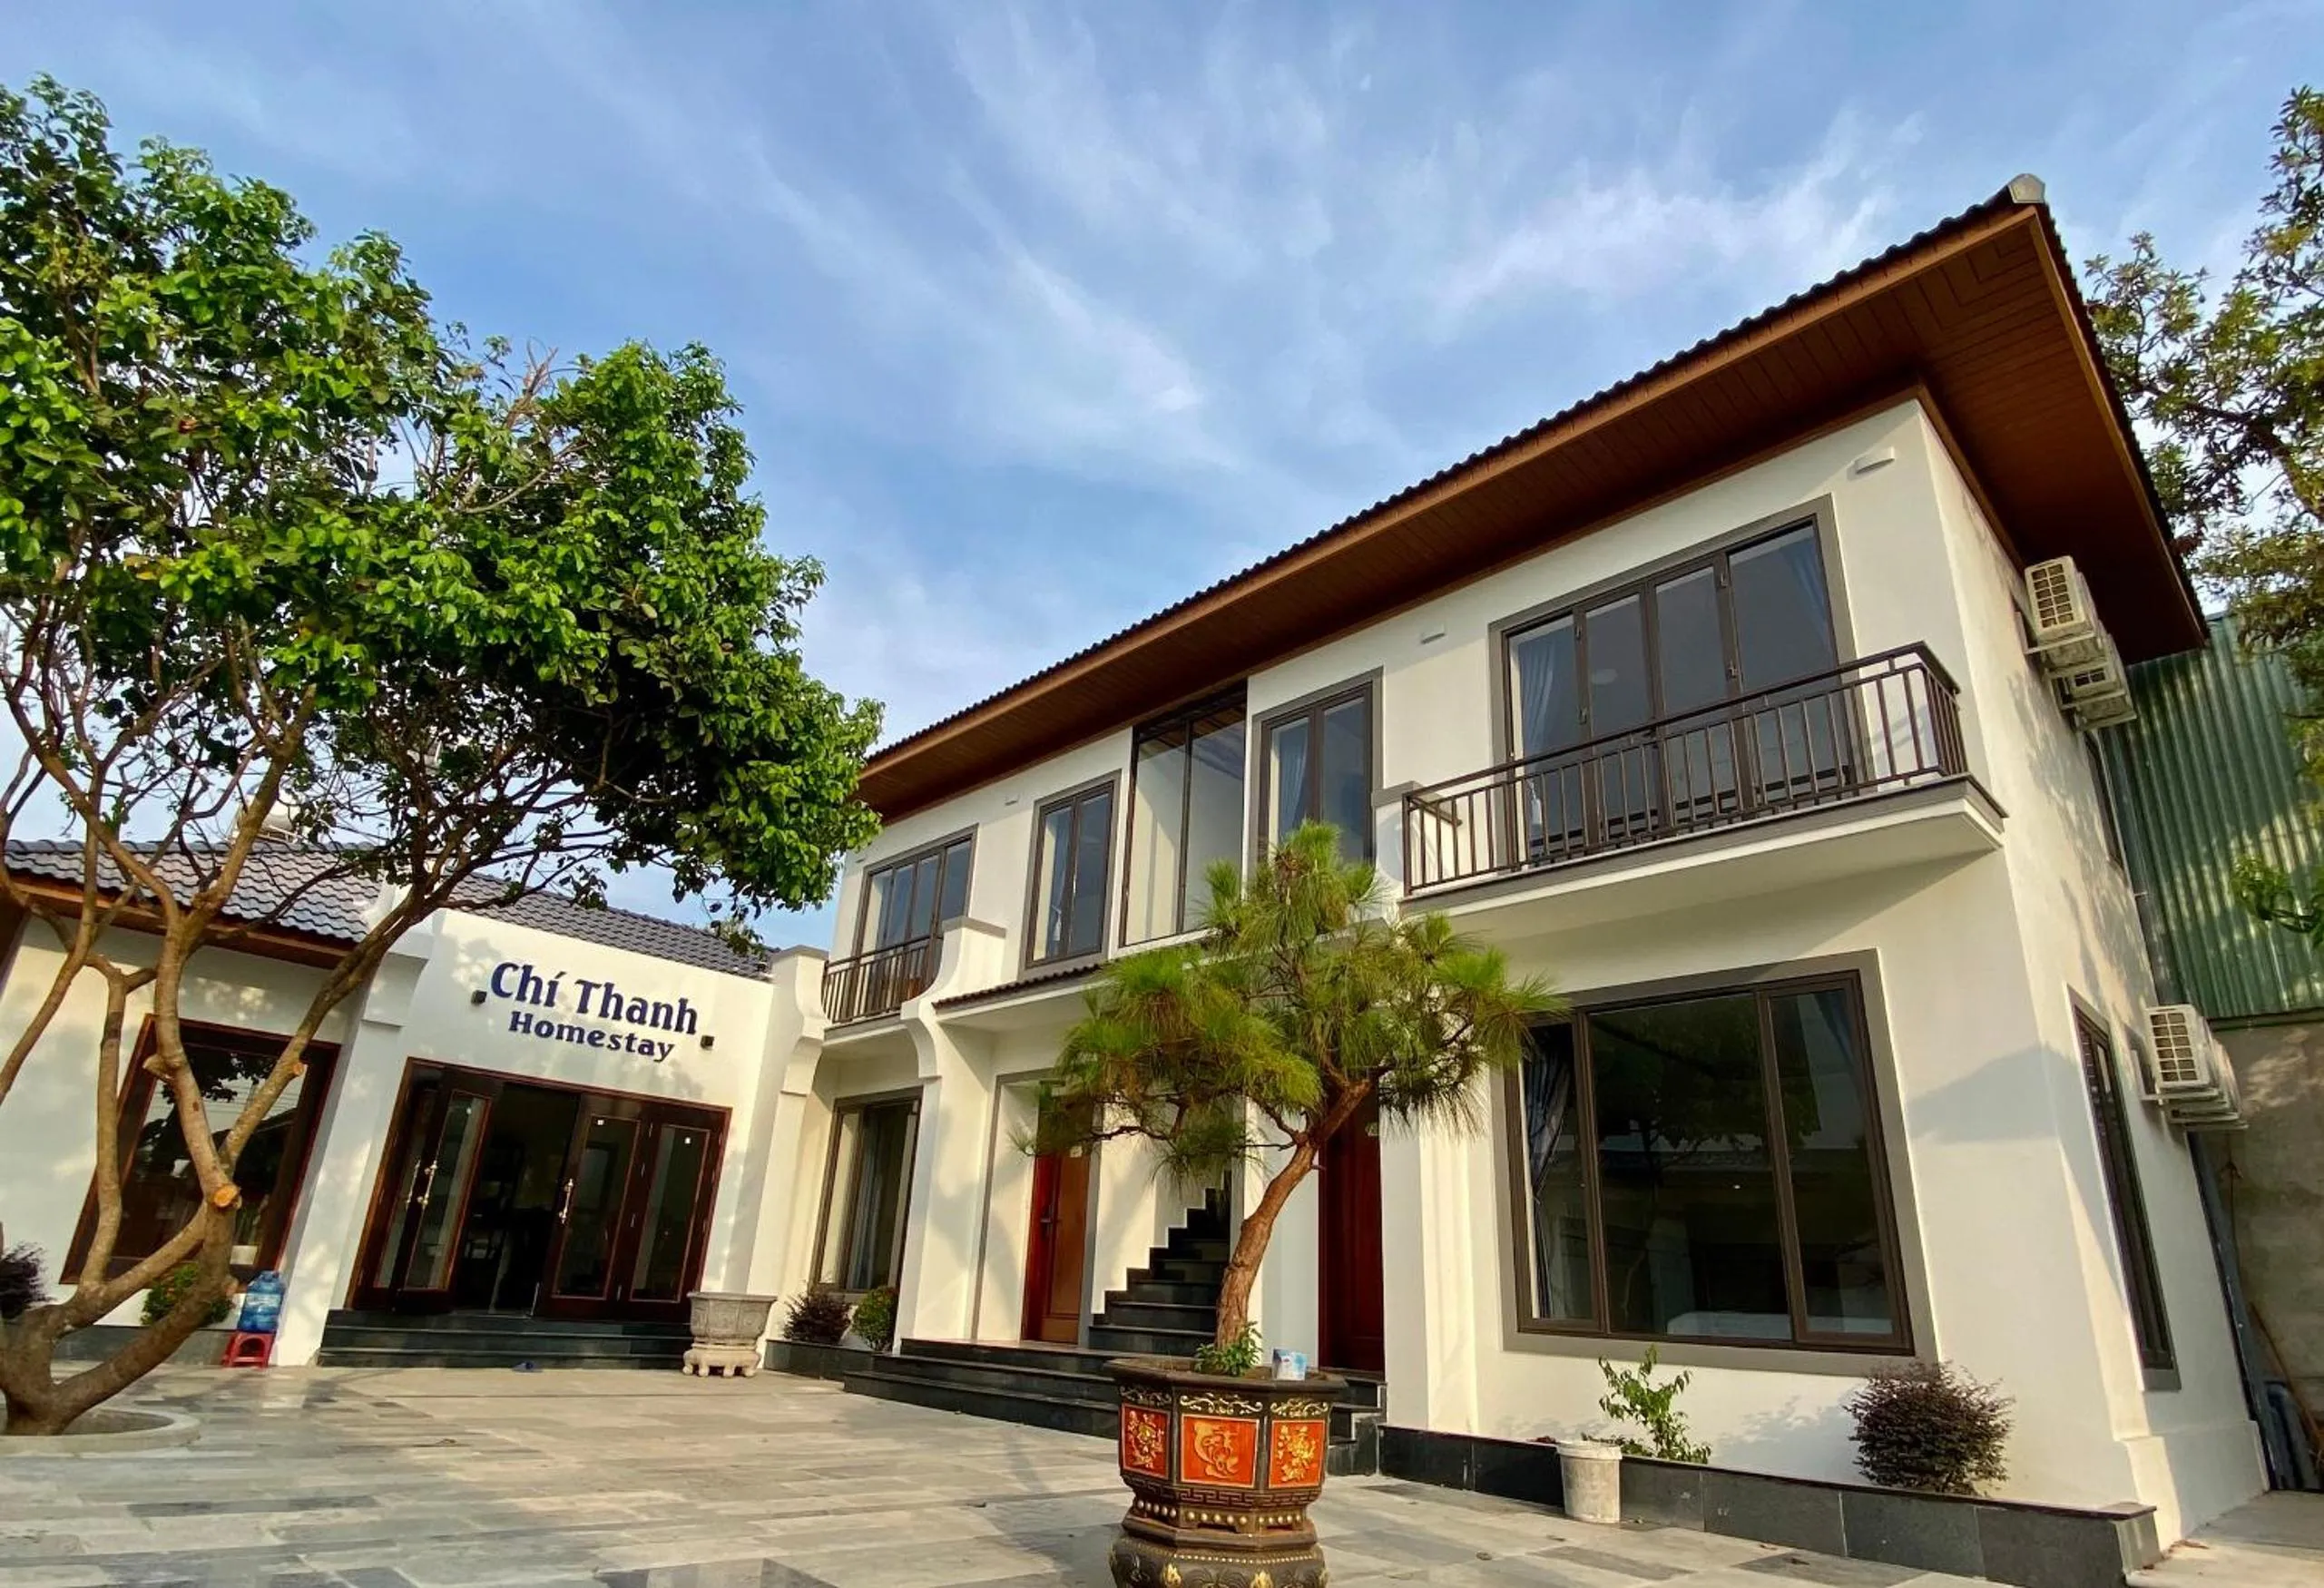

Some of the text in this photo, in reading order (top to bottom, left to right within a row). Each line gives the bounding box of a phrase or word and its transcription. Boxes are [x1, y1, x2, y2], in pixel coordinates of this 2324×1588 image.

[491, 962, 698, 1034] Chí Thanh
[509, 1011, 674, 1062] Homestay
